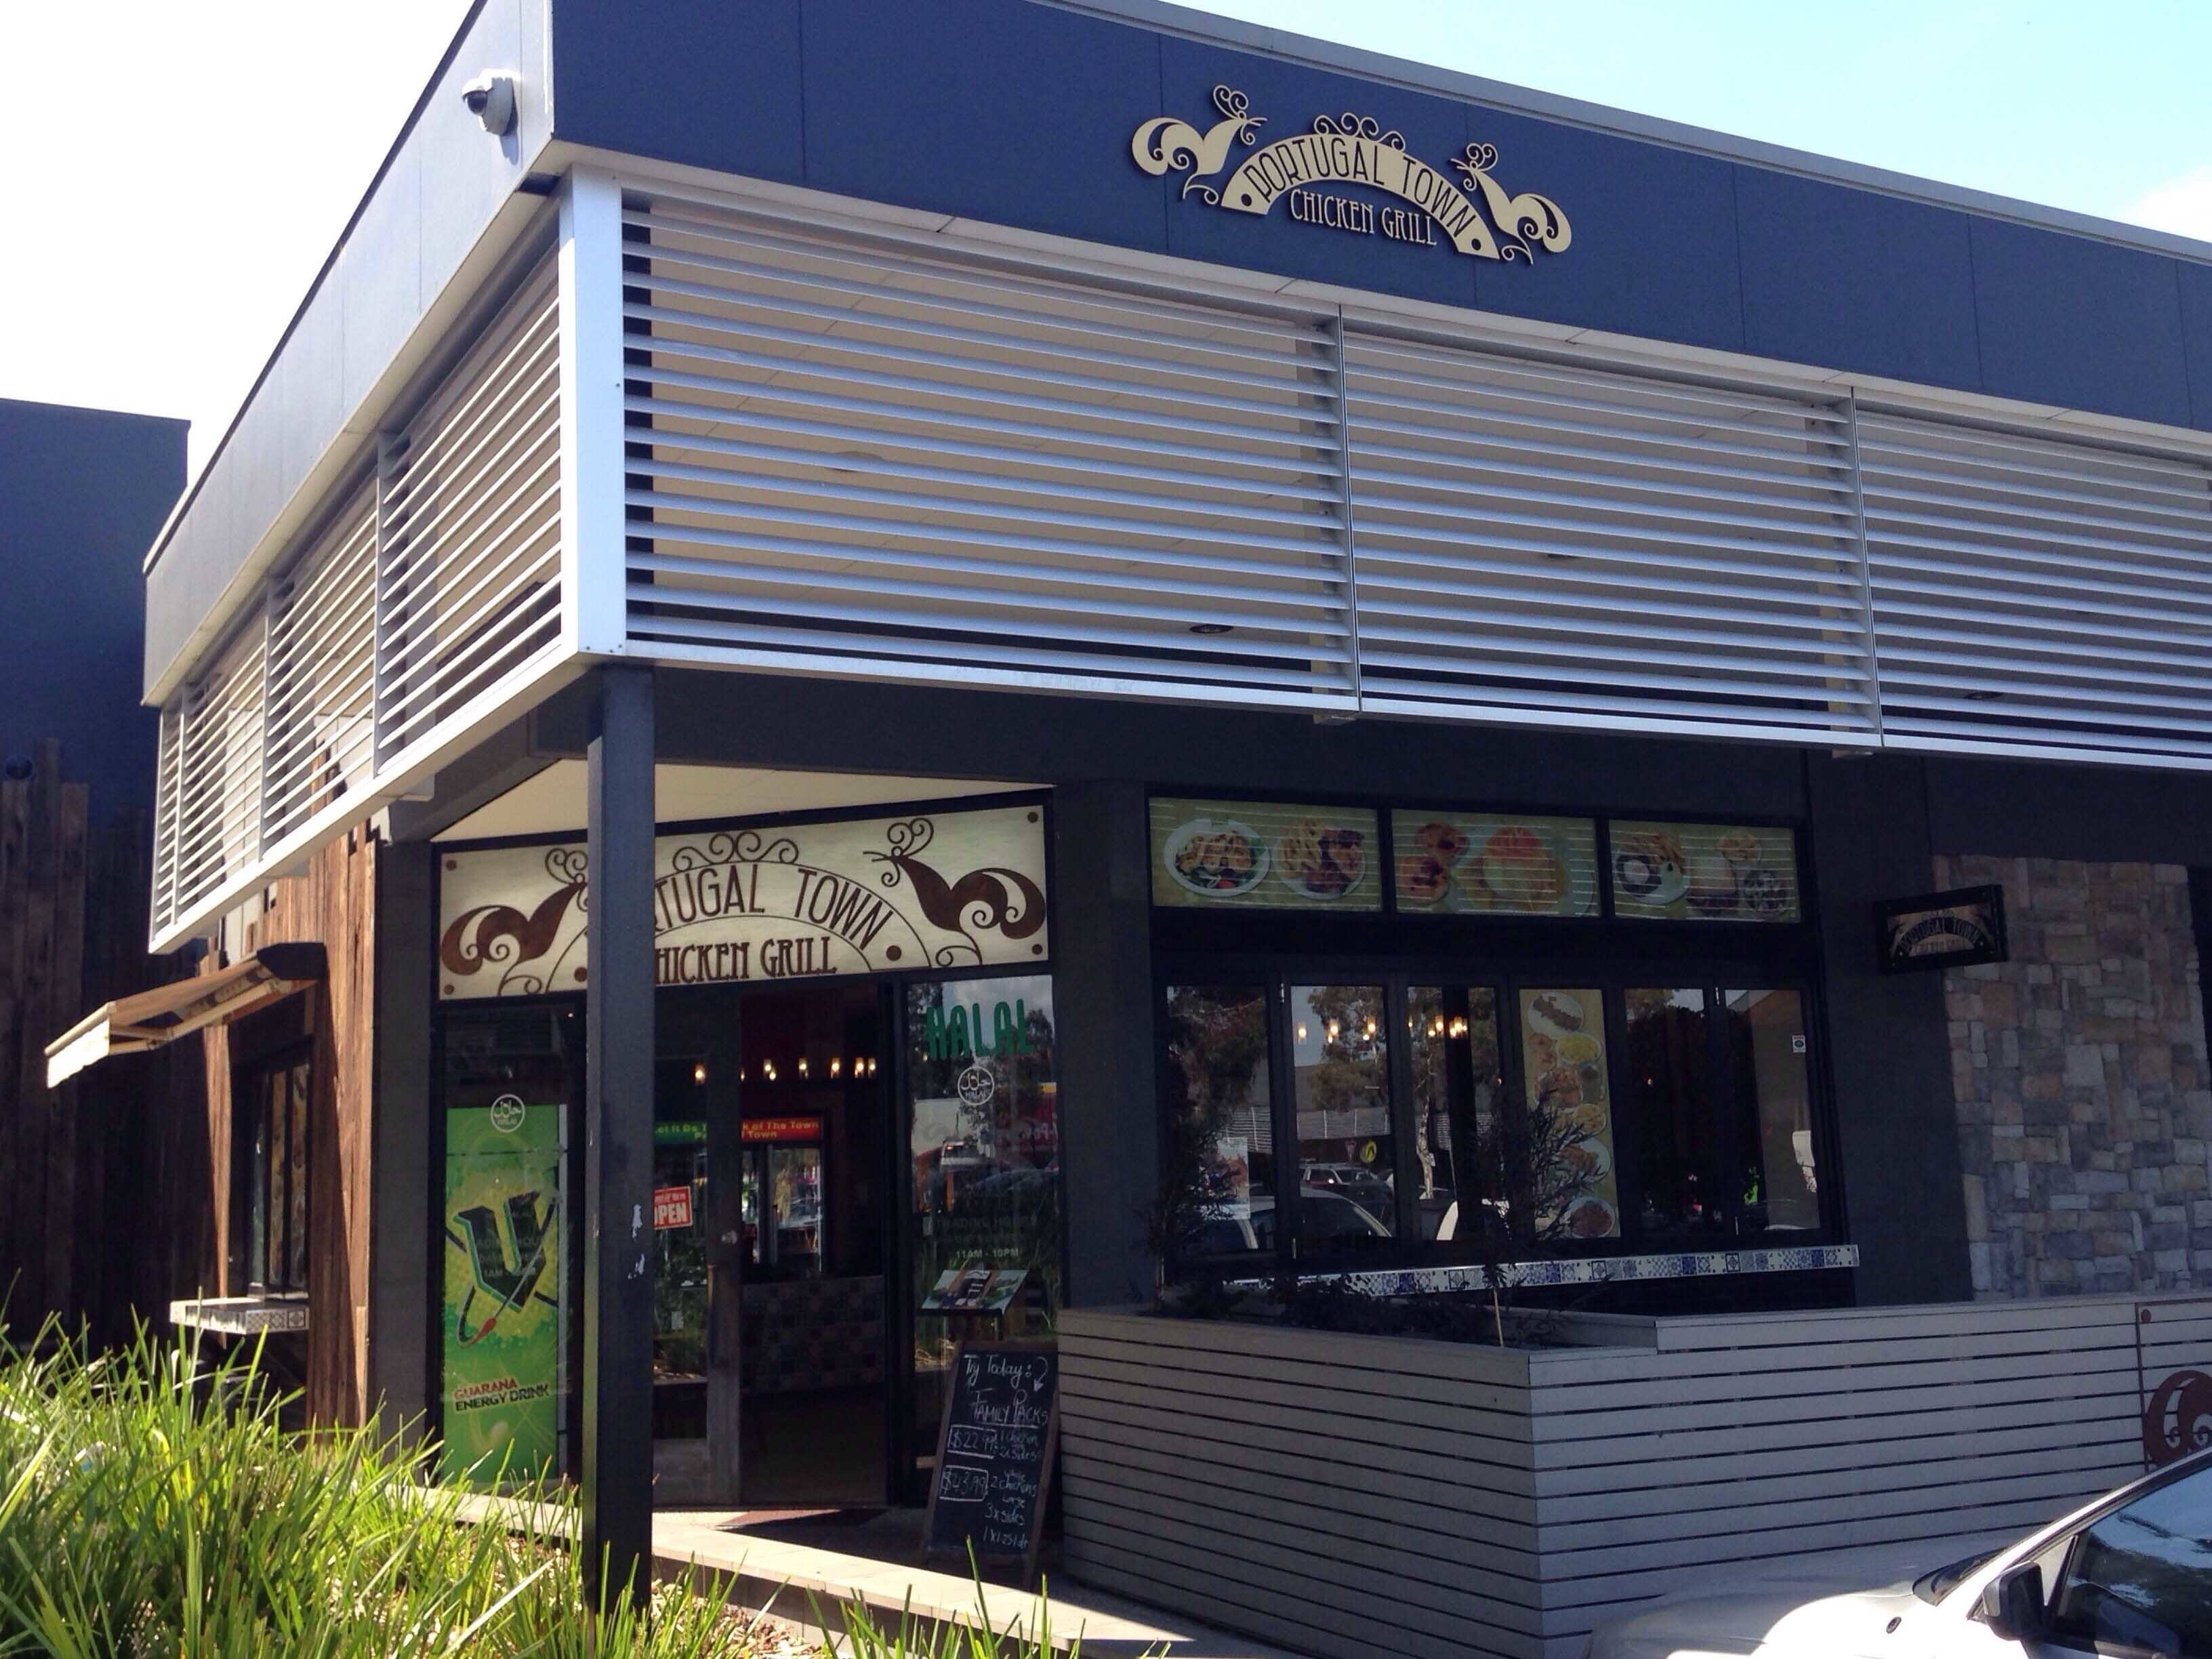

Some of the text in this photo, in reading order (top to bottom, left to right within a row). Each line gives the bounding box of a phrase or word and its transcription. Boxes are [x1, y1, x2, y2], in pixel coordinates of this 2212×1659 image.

[1244, 137, 1476, 238] PORTUGAL TOWN
[1290, 189, 1437, 245] CHICKEN GRILL
[654, 864, 893, 951] TUGAL TOWN
[655, 936, 838, 985] HICKEN GRILL
[926, 998, 1035, 1059] HALAL
[453, 1376, 518, 1399] GUARANA
[455, 1383, 550, 1412] ENERGY DRINK
